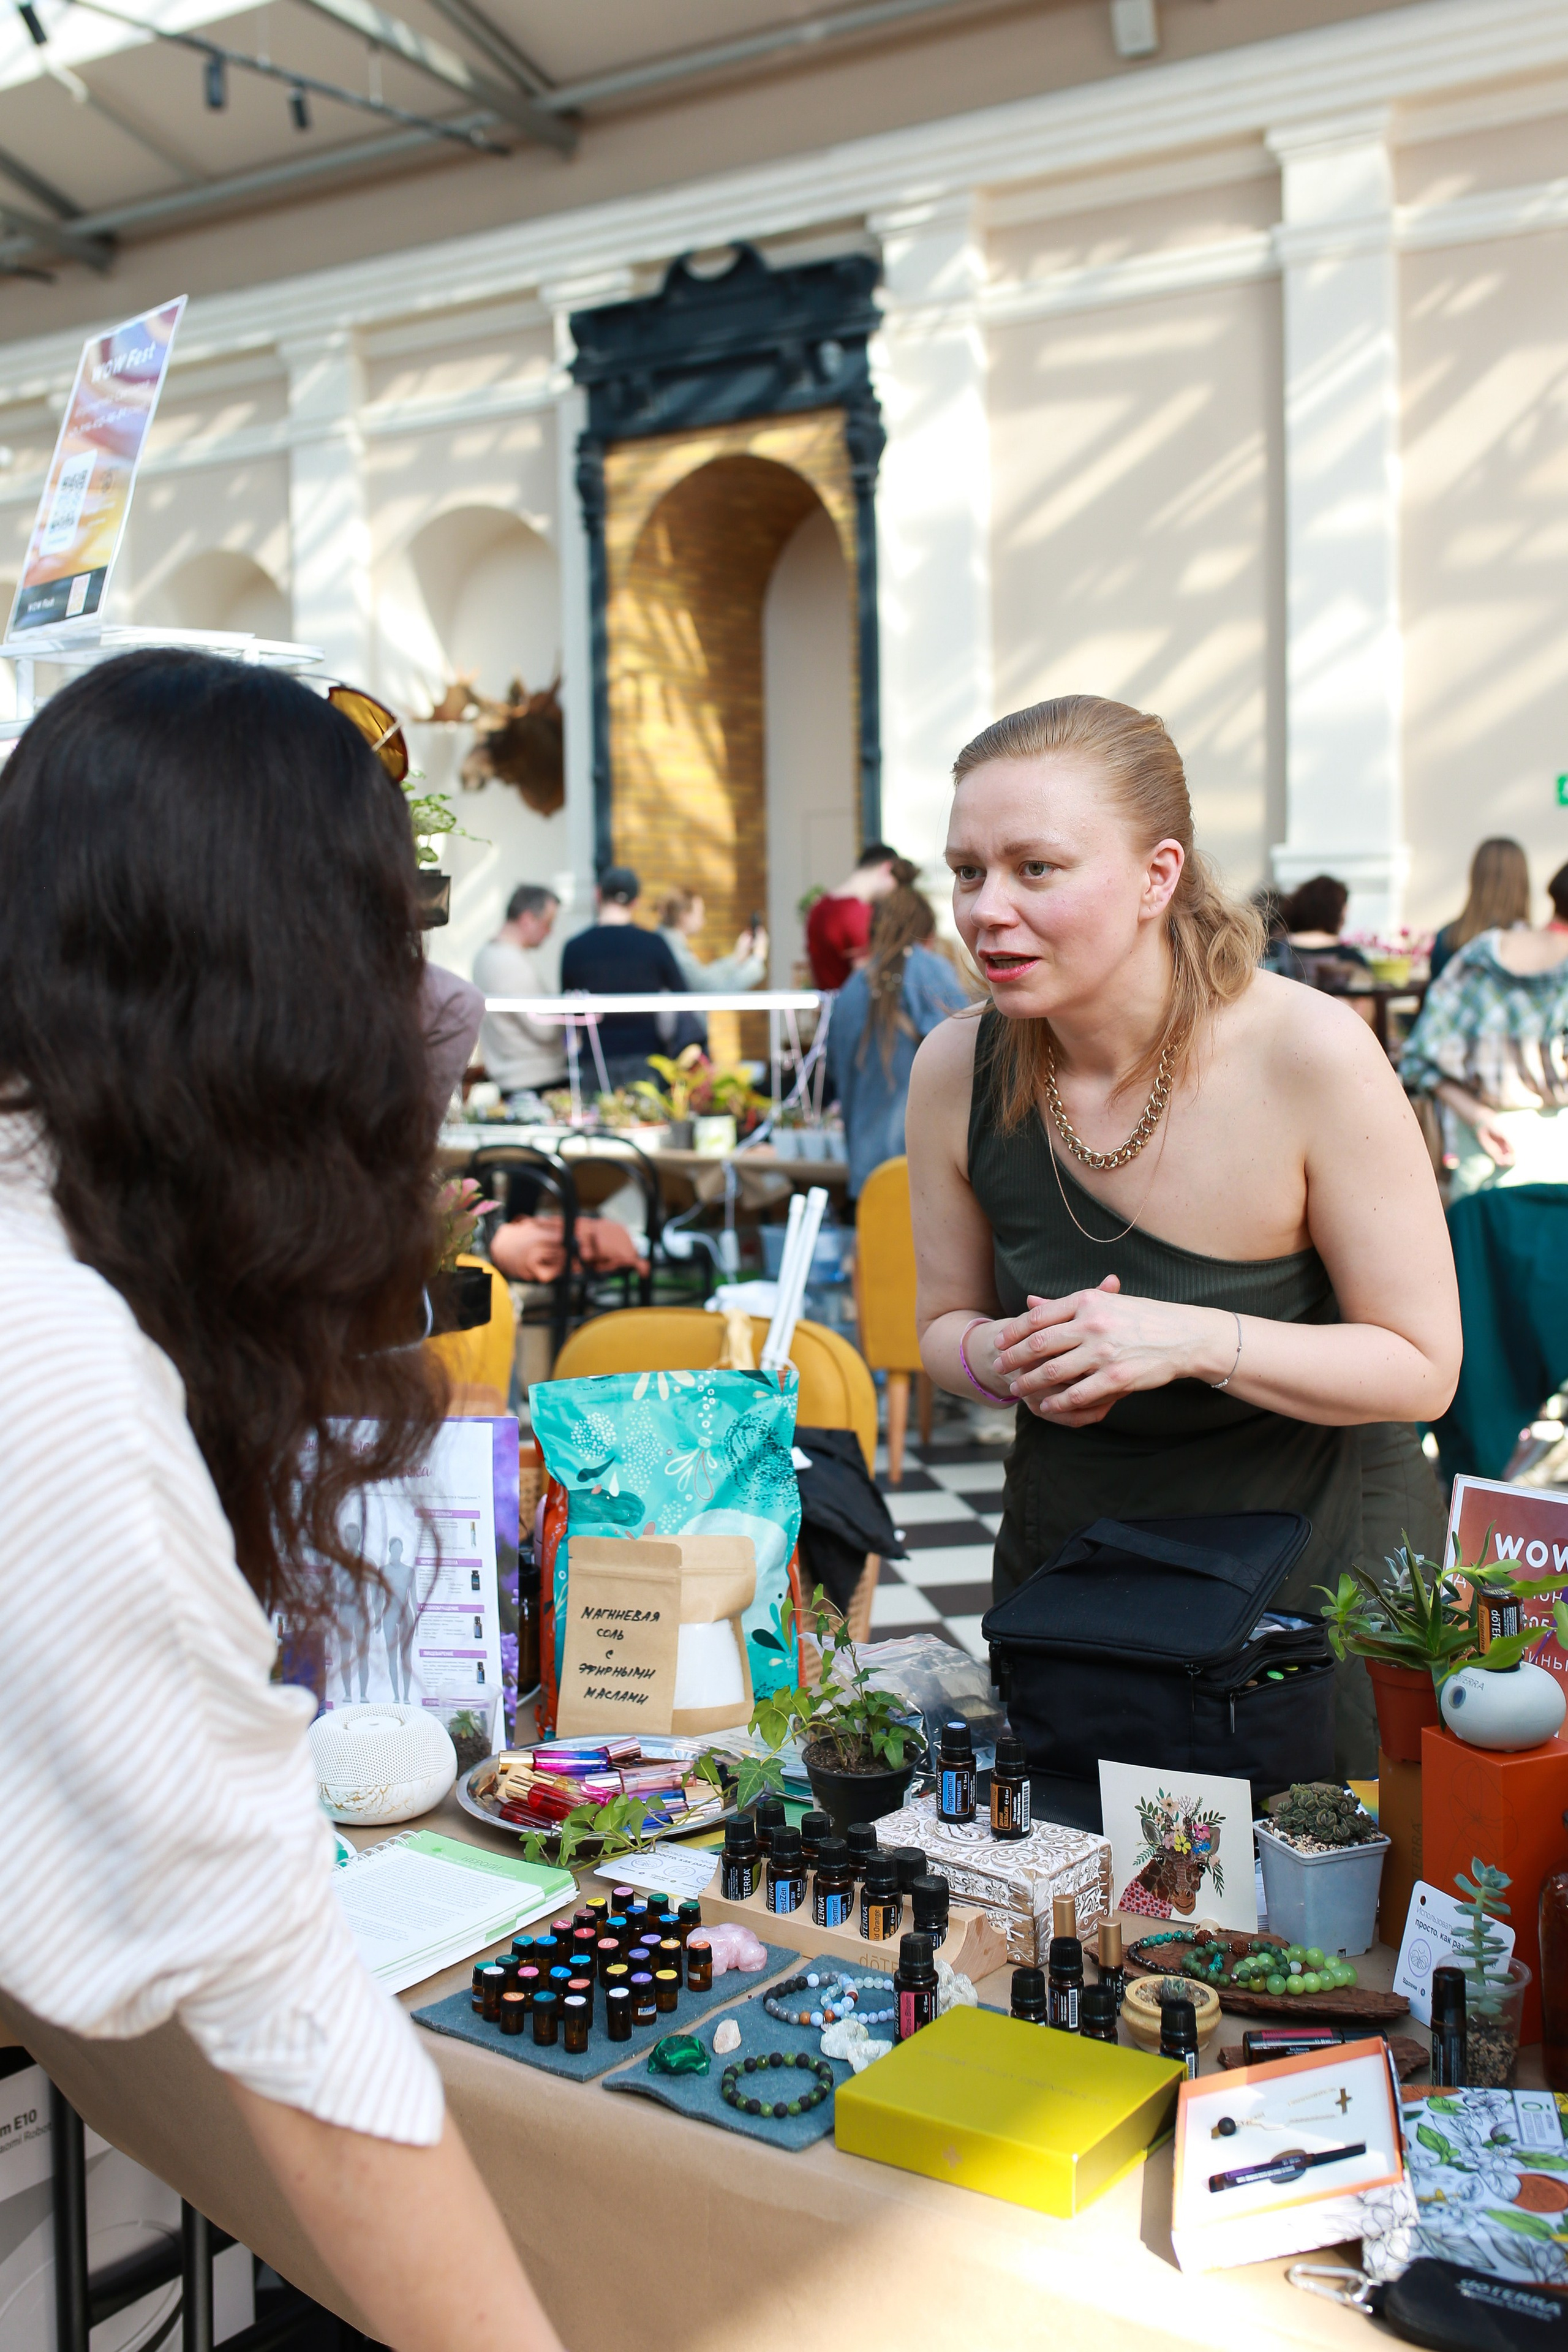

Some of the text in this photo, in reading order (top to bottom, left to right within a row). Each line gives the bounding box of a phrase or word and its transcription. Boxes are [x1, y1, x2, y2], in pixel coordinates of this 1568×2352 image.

[597, 1628, 624, 1640] СОЛЬ
[579, 1663, 656, 1679] ЭФИРНЫМИ
[583, 1686, 649, 1705] МАСЛАМИ
[1415, 1918, 1439, 1939] просто,
[1439, 1932, 1452, 1945] как
[13, 2109, 37, 2130] E10
